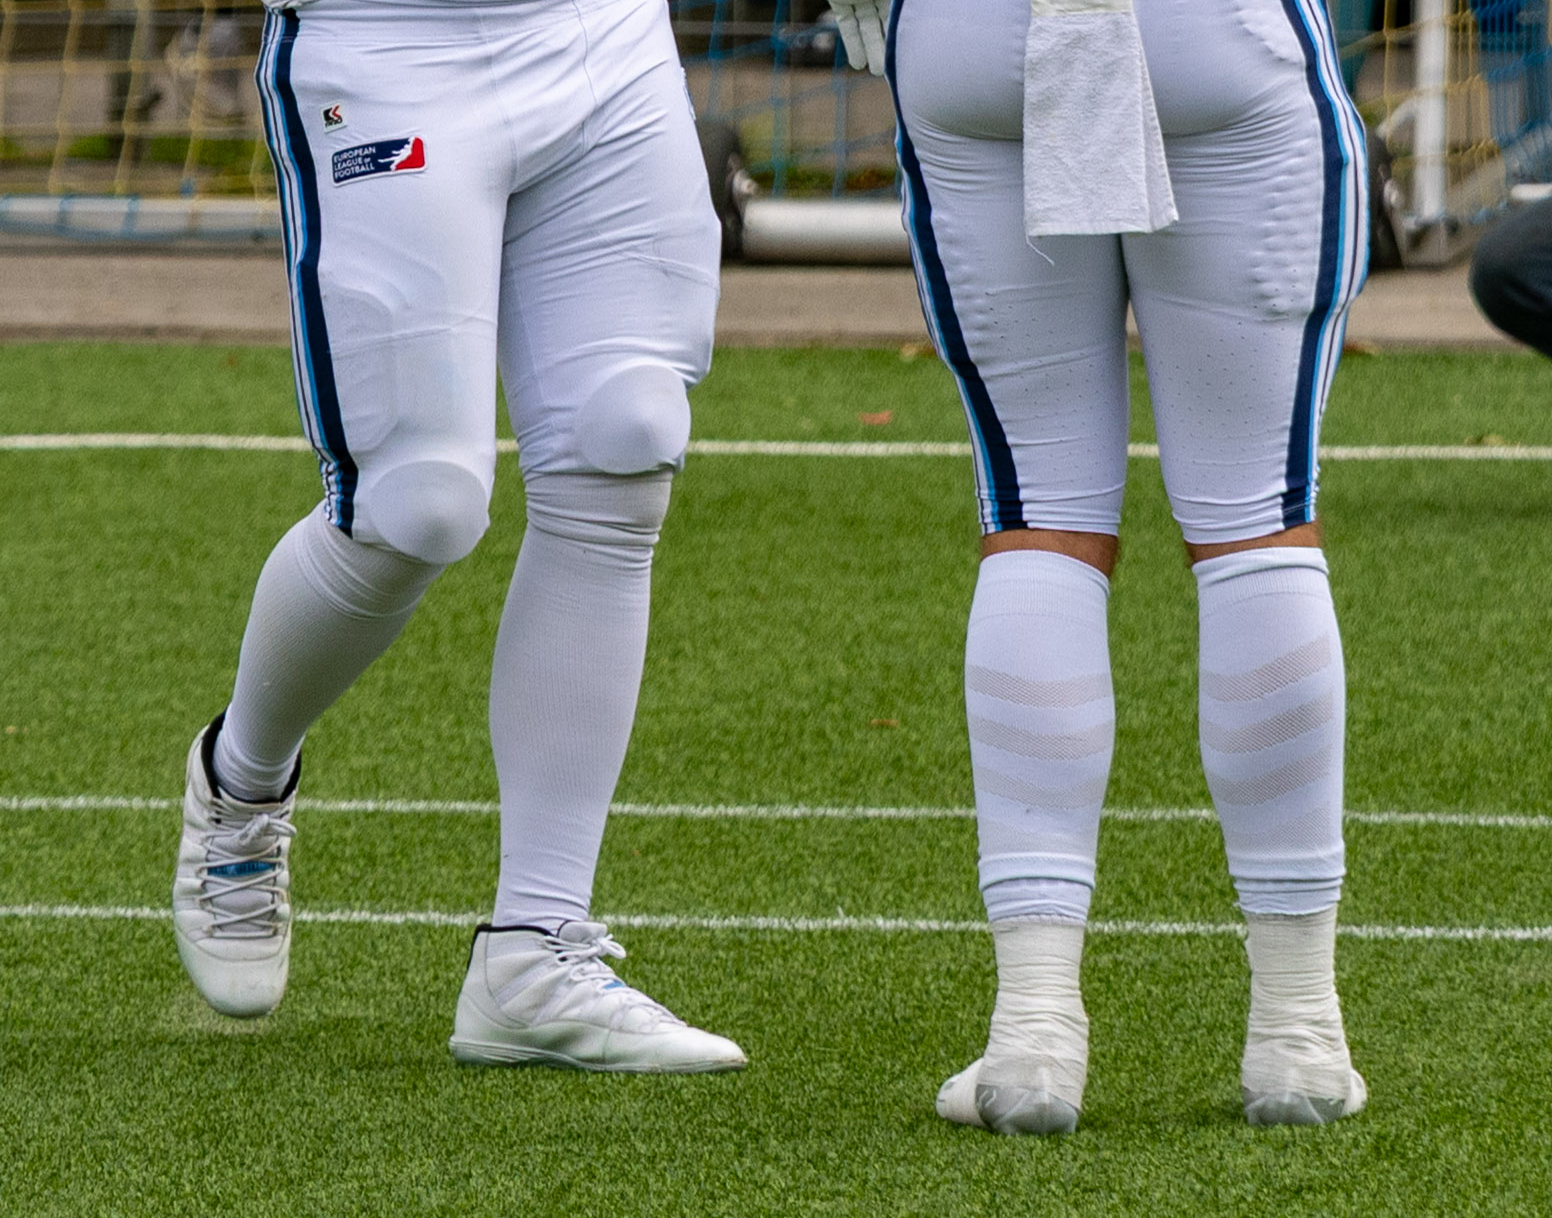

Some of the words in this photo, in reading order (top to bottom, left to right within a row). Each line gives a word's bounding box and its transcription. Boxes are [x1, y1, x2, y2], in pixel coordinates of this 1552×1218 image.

[334, 146, 376, 163] EUROPEAN
[334, 158, 363, 171] LEAGUE
[335, 163, 375, 179] FOOTBALL
